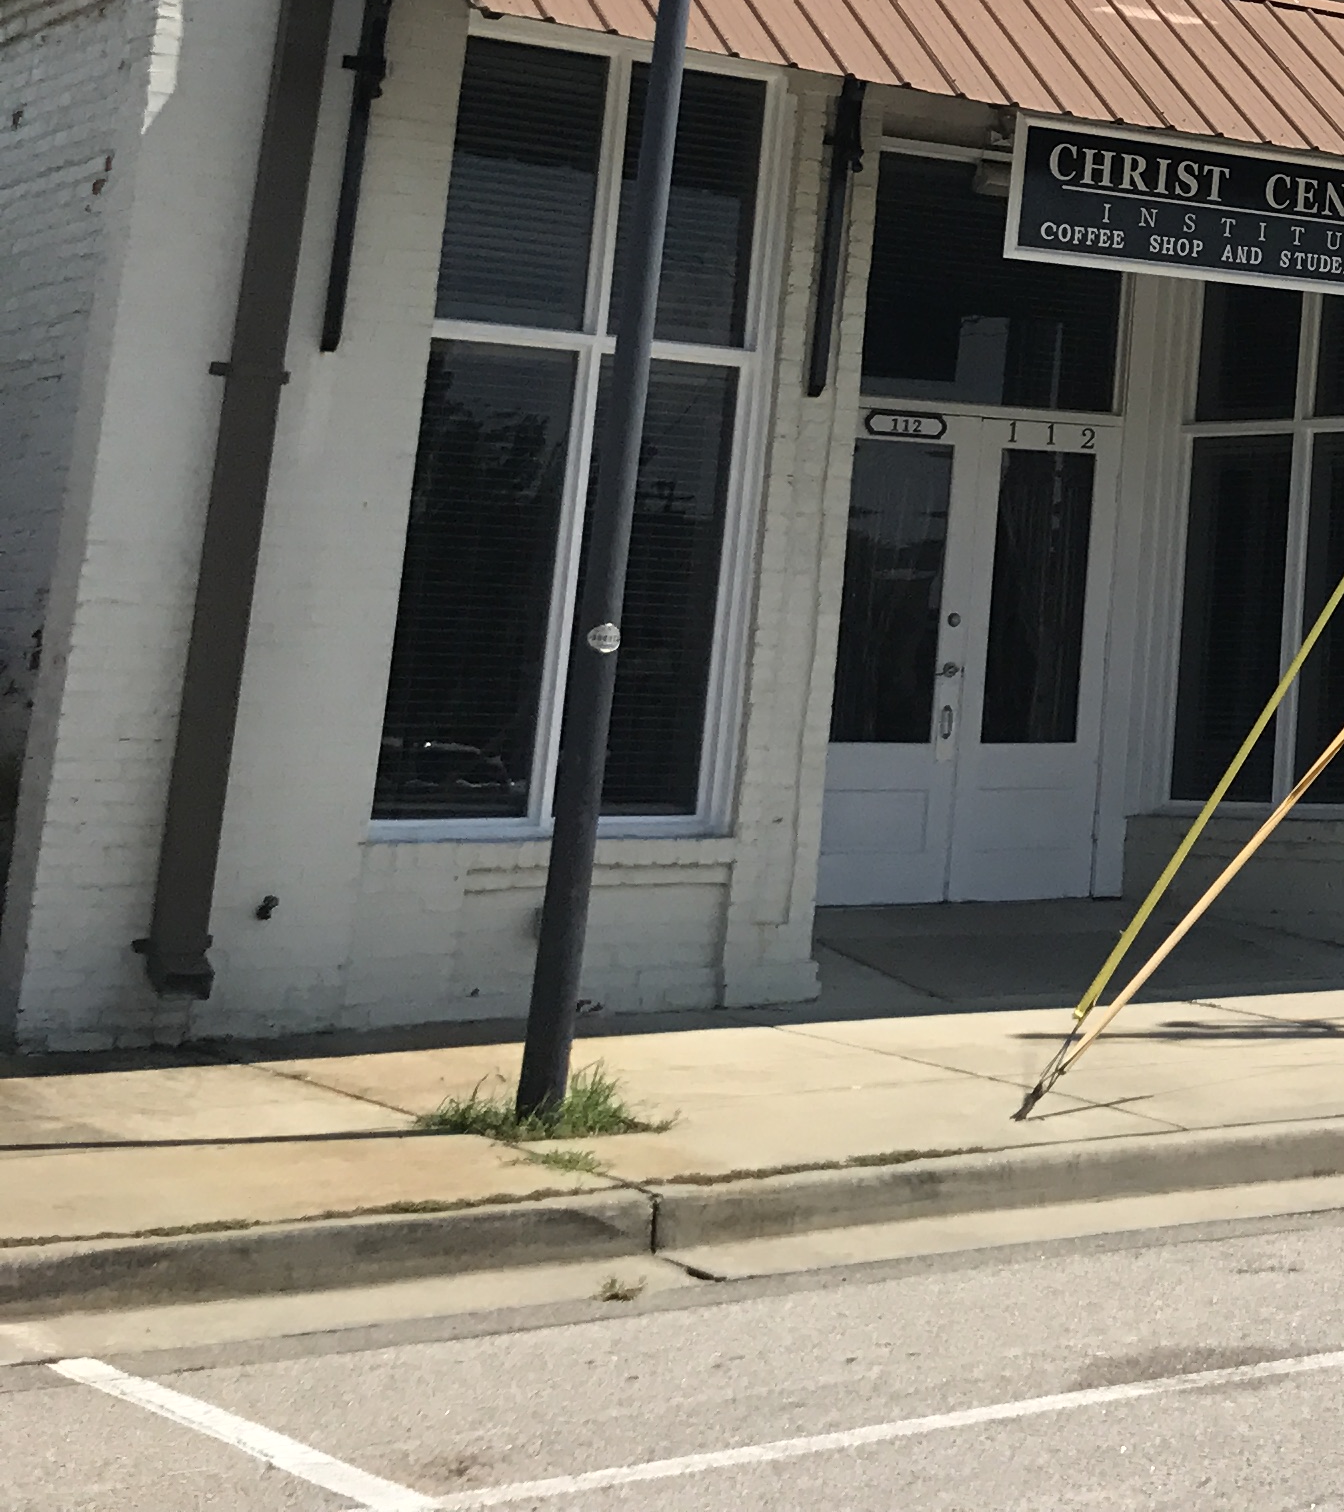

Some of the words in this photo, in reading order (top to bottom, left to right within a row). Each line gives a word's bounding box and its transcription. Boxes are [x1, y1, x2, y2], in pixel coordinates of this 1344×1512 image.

[1048, 142, 1231, 202] CHRIST
[1040, 221, 1126, 250] COFFEE
[1149, 234, 1204, 259] SHOP
[1221, 242, 1263, 266] AND
[890, 417, 922, 434] 112
